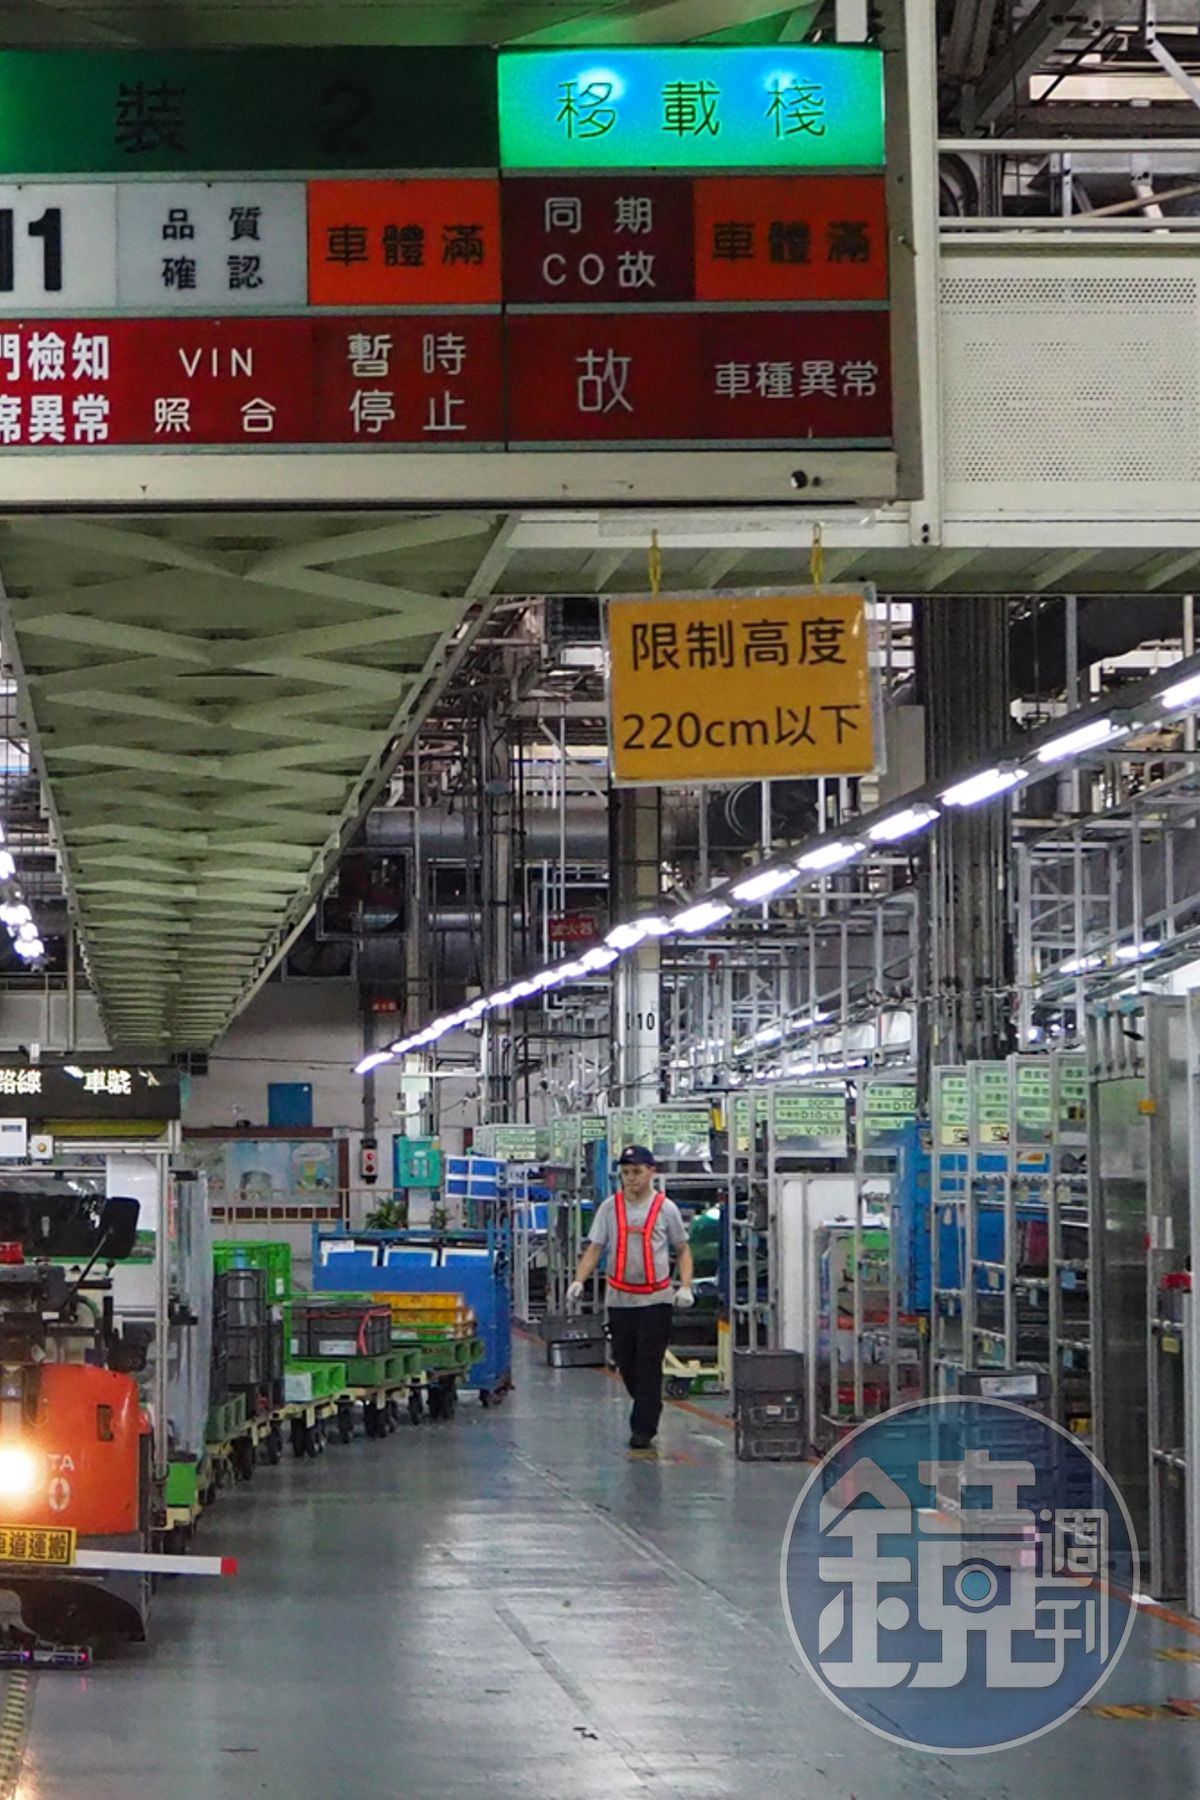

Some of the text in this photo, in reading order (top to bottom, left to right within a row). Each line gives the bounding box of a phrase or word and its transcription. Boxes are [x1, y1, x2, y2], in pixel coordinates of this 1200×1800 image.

[326, 223, 485, 268] 車體滿
[711, 220, 871, 265] 車體滿
[179, 347, 255, 377] VIN
[575, 349, 634, 414] 故
[713, 360, 880, 400] 車種異常
[631, 617, 847, 671] 限制高度
[623, 703, 861, 749] 220cm以下
